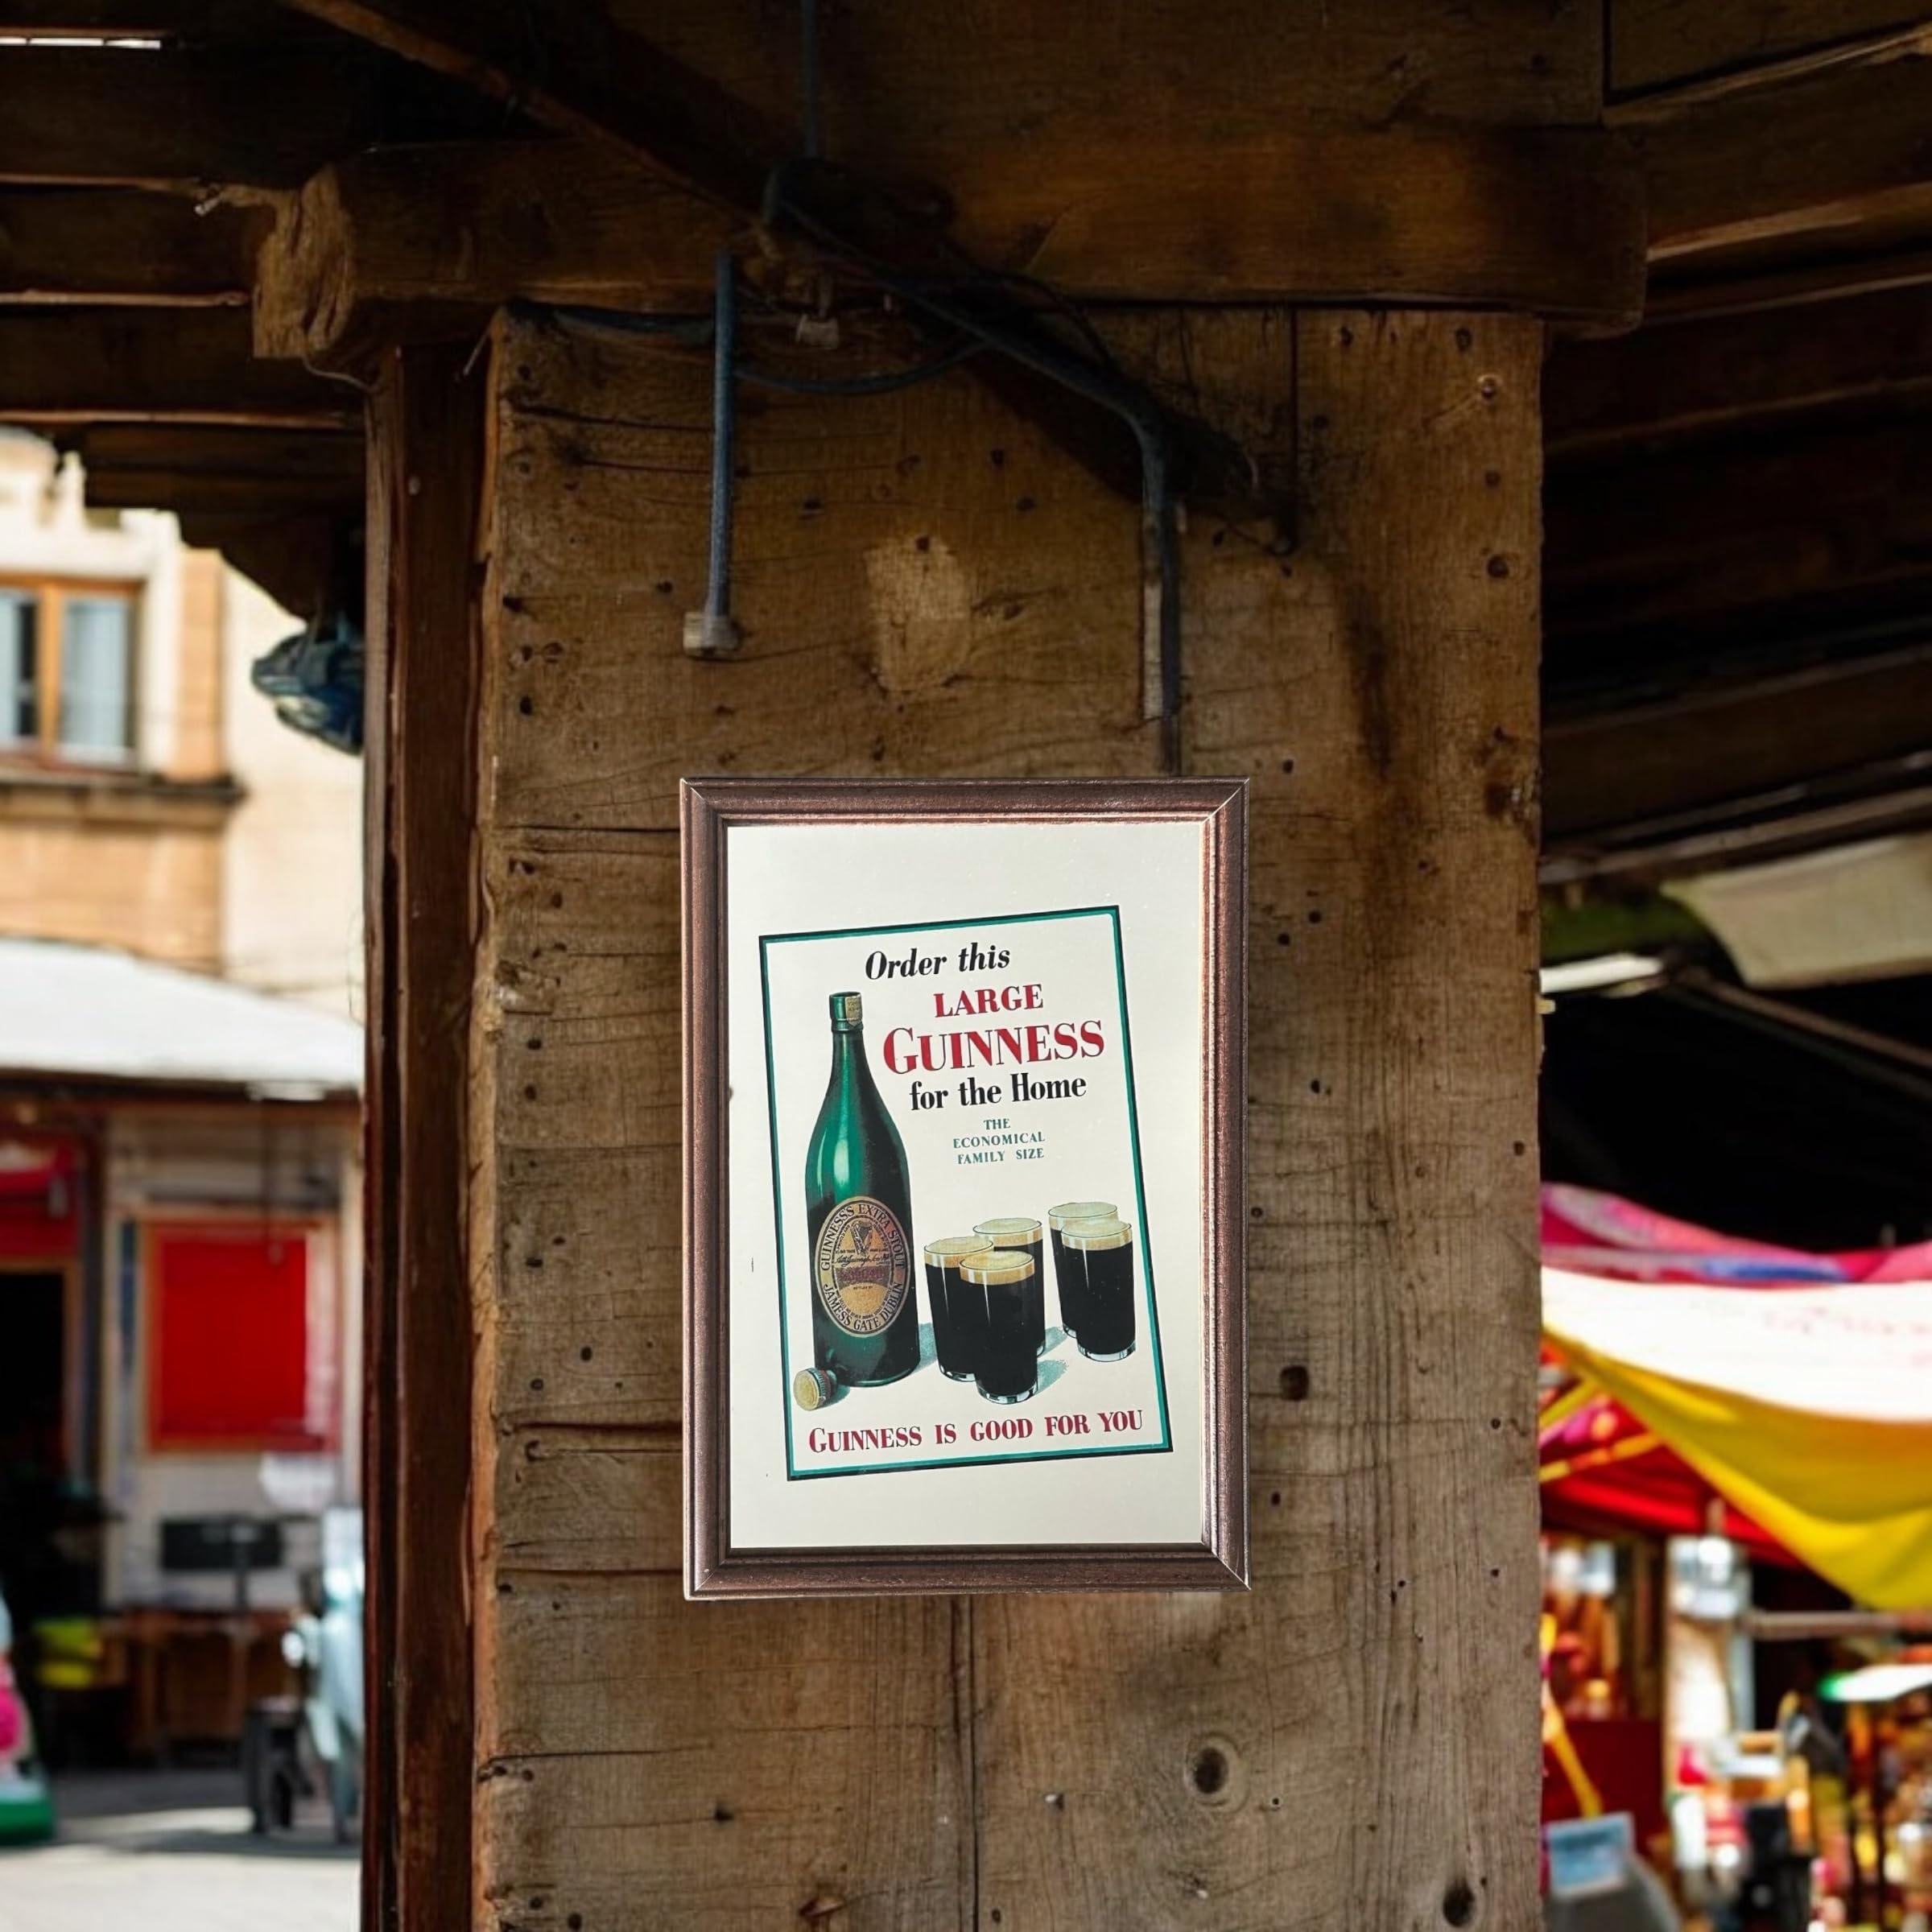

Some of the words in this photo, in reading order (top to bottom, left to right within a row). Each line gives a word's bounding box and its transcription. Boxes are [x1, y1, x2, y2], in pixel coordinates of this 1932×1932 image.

[865, 947, 947, 980] Order
[958, 942, 1010, 972] this
[934, 984, 1044, 1018] LARGE
[883, 1020, 1104, 1075] GUINNESS
[910, 1081, 948, 1111] for
[958, 1077, 1001, 1107] the
[1010, 1072, 1087, 1103] Home
[953, 1131, 1046, 1149] ECONOMICAL
[984, 1118, 1011, 1130] THE
[957, 1150, 1005, 1165] FAMILY
[1016, 1148, 1044, 1160] SIZE
[858, 1204, 890, 1228] EXTRA
[888, 1230, 906, 1269] STOUT
[854, 1317, 881, 1331] GATE
[880, 1282, 902, 1321] DUBLIN
[809, 1426, 923, 1454] GUINNESS
[935, 1423, 956, 1445] IS
[971, 1418, 1034, 1442] GOOD
[1046, 1414, 1092, 1437] FOR
[1098, 1409, 1143, 1433] YOU
